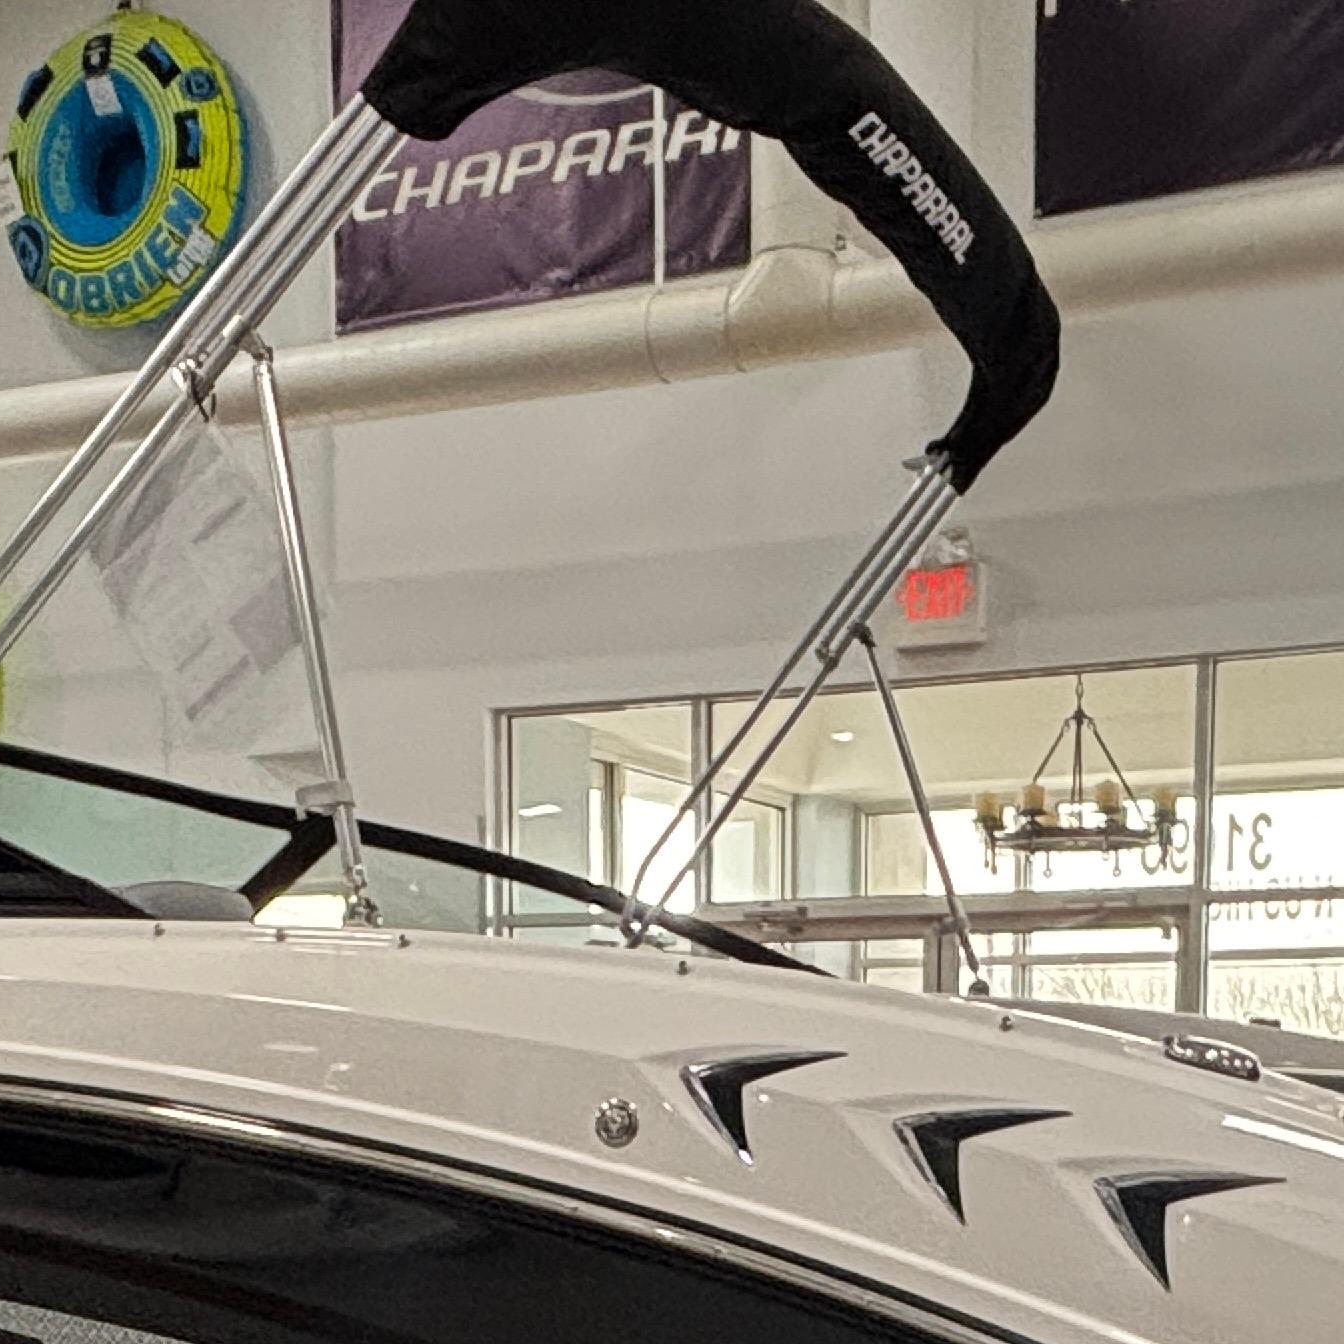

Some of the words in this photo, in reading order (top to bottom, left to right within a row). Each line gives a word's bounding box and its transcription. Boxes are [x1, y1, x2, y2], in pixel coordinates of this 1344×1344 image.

[352, 110, 740, 222] CHAPARR
[848, 111, 975, 266] CHAPARRAL
[49, 187, 206, 313] OBRIEN
[906, 565, 967, 621] EXIT
